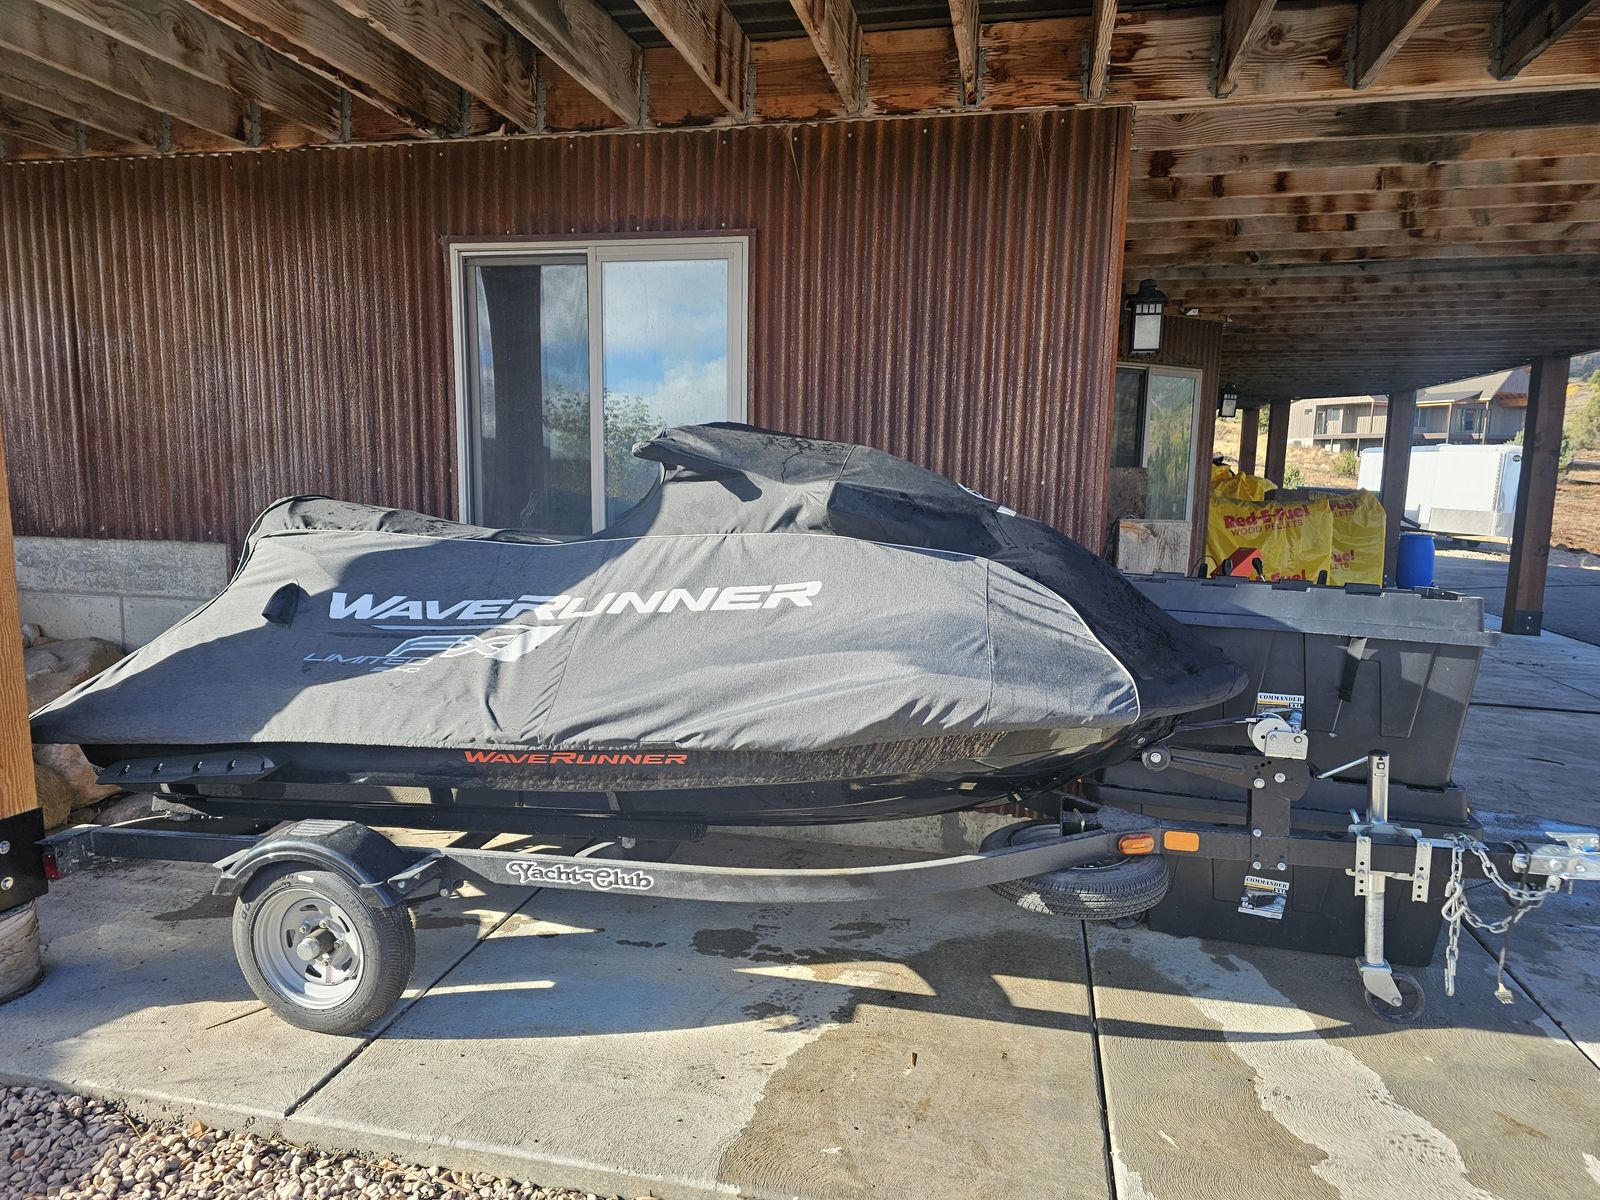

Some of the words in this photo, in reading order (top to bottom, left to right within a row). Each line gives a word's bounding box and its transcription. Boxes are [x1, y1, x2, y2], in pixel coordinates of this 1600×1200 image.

[1223, 504, 1310, 529] Red-E-Fuel
[1231, 526, 1262, 537] WOOD
[1265, 519, 1304, 532] PELLETS
[328, 581, 822, 621] WAVERUNNER
[303, 653, 433, 666] LIMITED
[1259, 694, 1303, 703] COMMANDER
[464, 751, 688, 765] WAVERUNNER
[1246, 877, 1288, 888] COMMANDER
